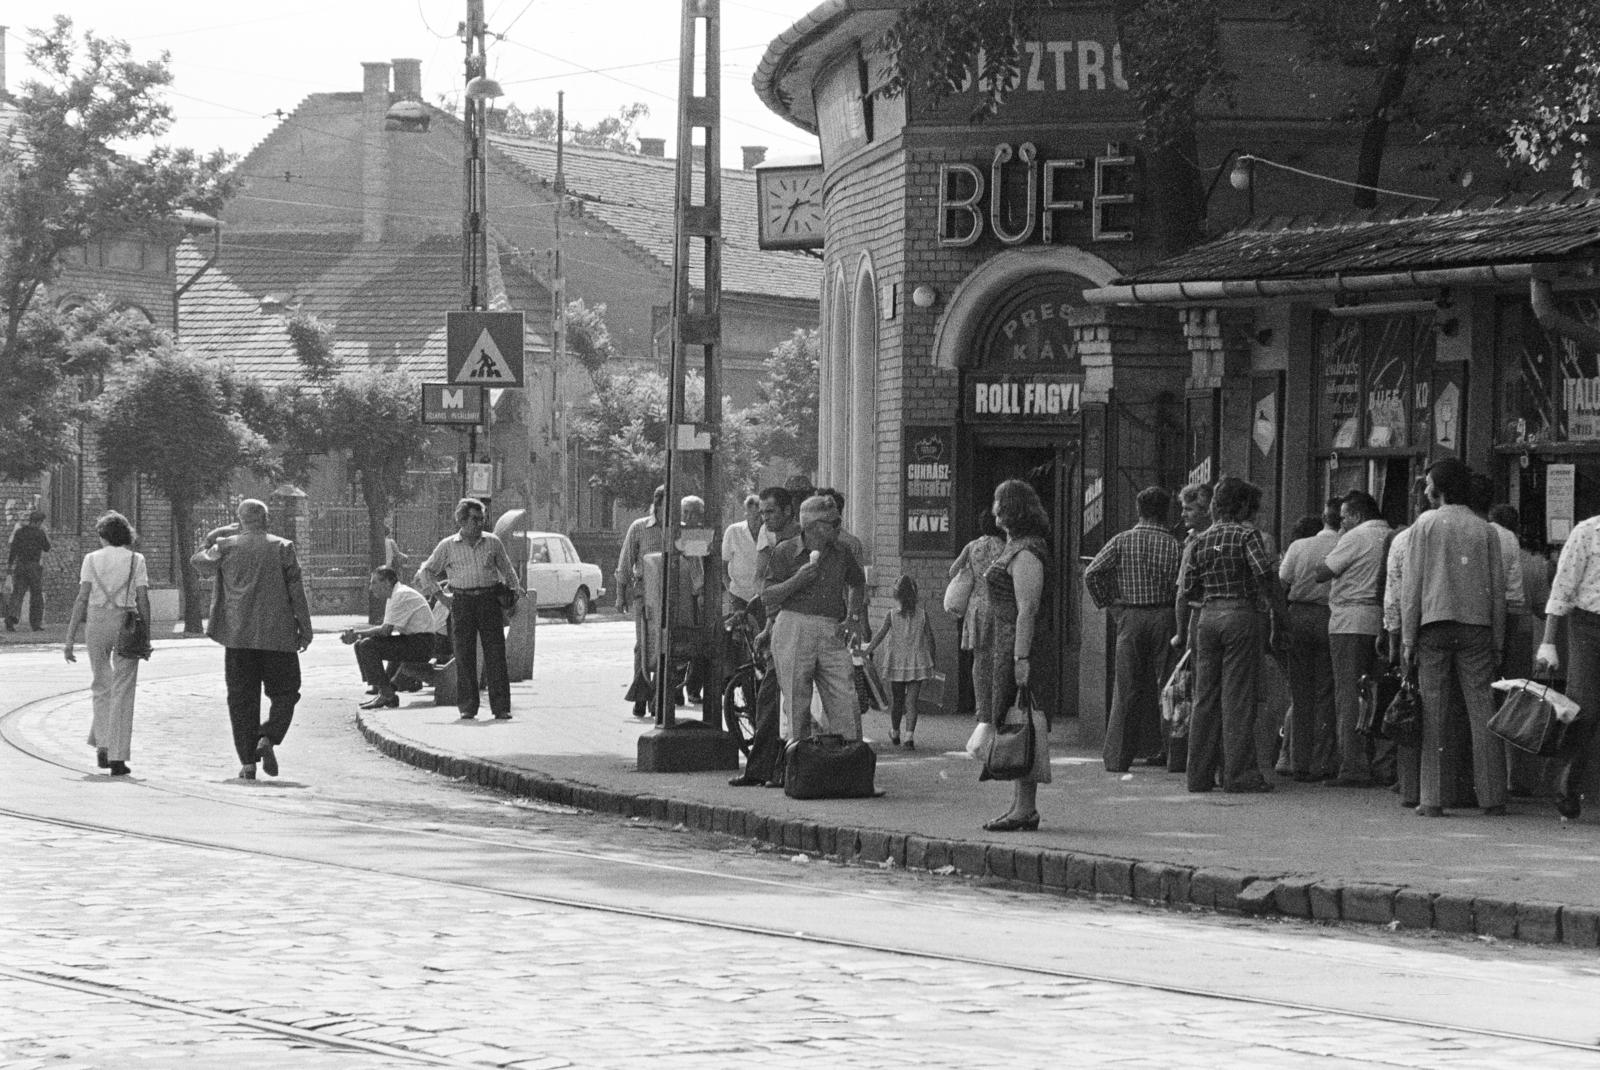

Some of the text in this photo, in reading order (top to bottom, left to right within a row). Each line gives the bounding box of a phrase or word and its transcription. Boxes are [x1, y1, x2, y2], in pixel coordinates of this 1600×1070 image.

[937, 142, 1136, 247] BÜFÉ
[442, 389, 464, 409] M
[975, 382, 1080, 416] ROLL FAGY!
[908, 513, 949, 532] KÁVÉ
